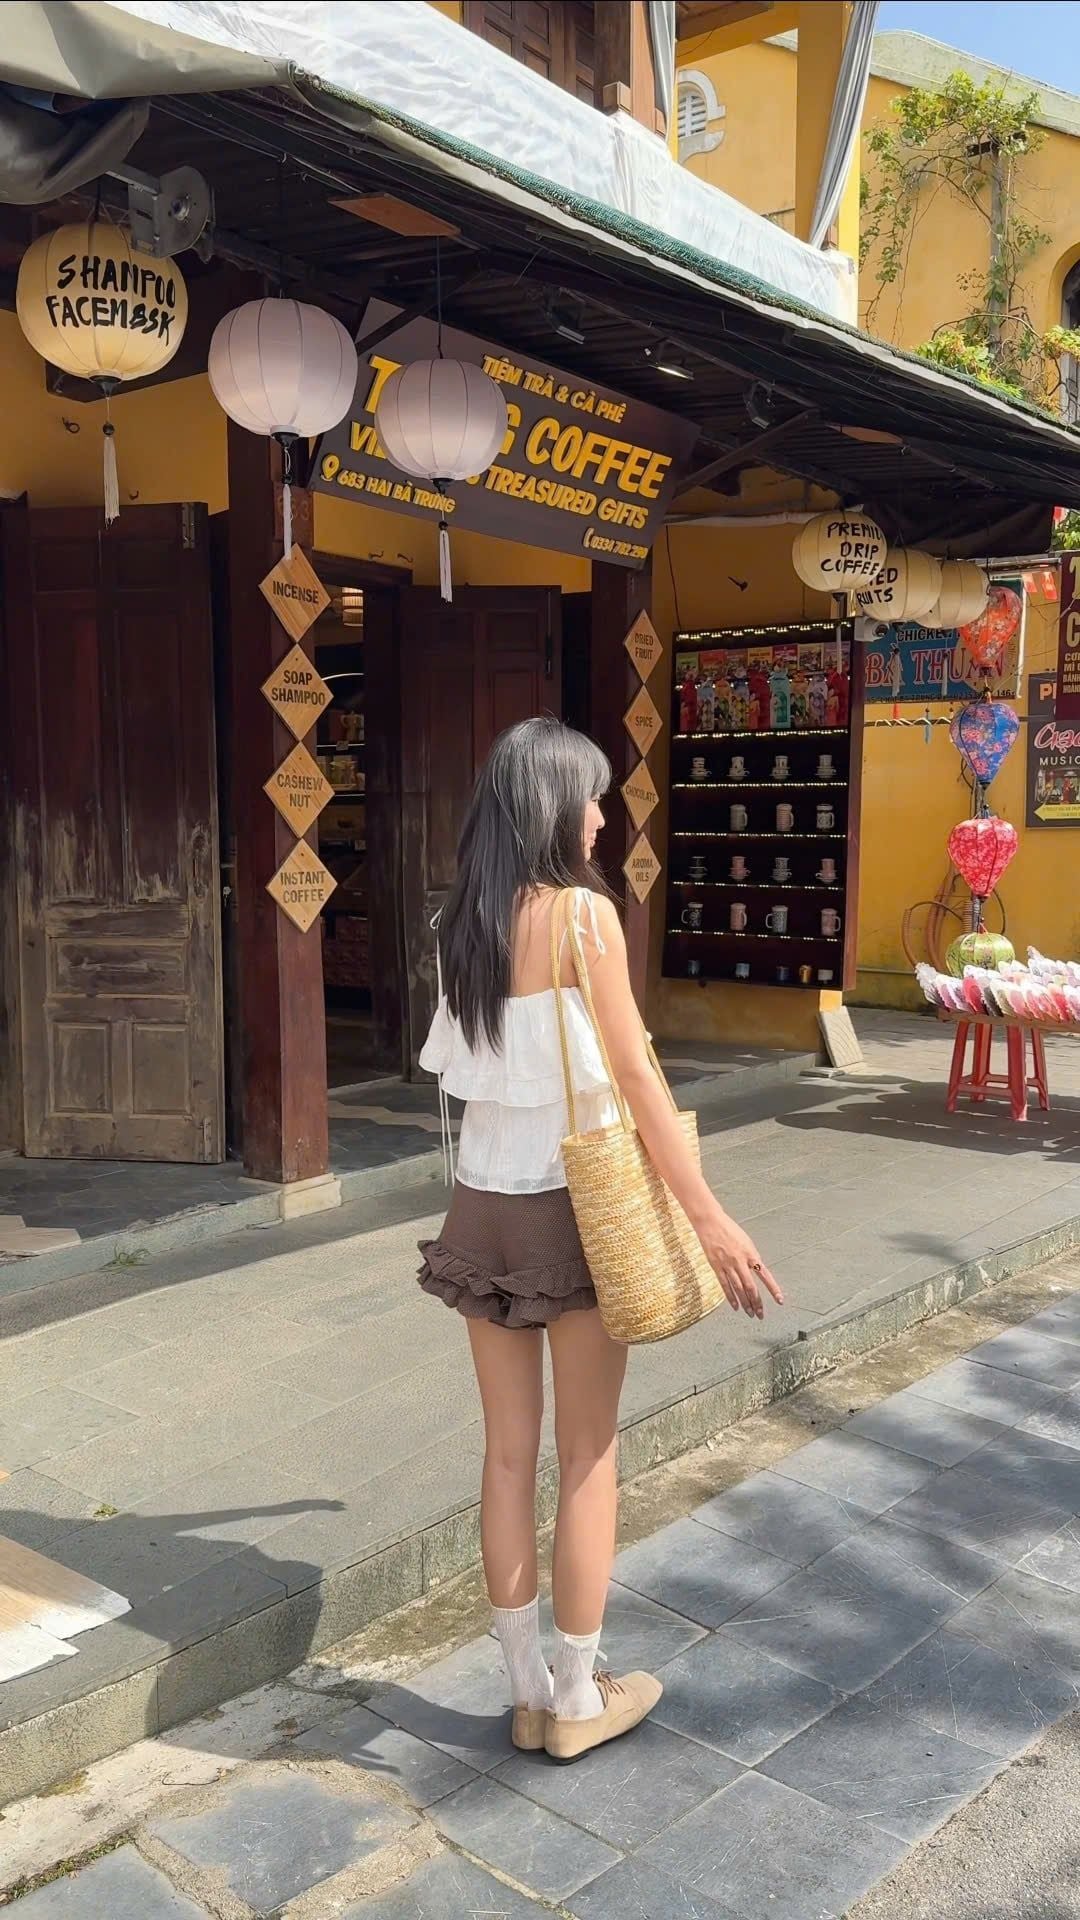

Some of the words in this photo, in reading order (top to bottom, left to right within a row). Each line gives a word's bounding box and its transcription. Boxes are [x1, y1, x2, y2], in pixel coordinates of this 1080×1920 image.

[523, 372, 555, 399] TRÀ
[555, 385, 569, 404] &
[570, 390, 596, 413] CÀ
[595, 400, 627, 424] PHÊ
[526, 416, 673, 498] COFFEE
[337, 470, 366, 490] 683
[365, 476, 393, 497] HAI
[392, 480, 413, 503] BÀ
[484, 465, 598, 516] TREASURED
[597, 498, 649, 529] GIFTS
[840, 541, 879, 560] DRIP
[820, 558, 880, 576] COFFEE
[272, 580, 319, 604] INCENSE
[634, 632, 654, 647] DRIED
[635, 646, 654, 661] FRUIT
[283, 669, 313, 686] SOAP
[271, 687, 326, 706] SHAMPOO
[635, 715, 653, 728] SPICE
[276, 773, 324, 791] CASHEW
[289, 793, 311, 808] NUT
[625, 784, 656, 804] CHOCOLATE
[631, 857, 654, 869] AROMA
[280, 870, 326, 886] INSTANT
[635, 871, 650, 882] OILS
[282, 888, 325, 904] COFFEE
